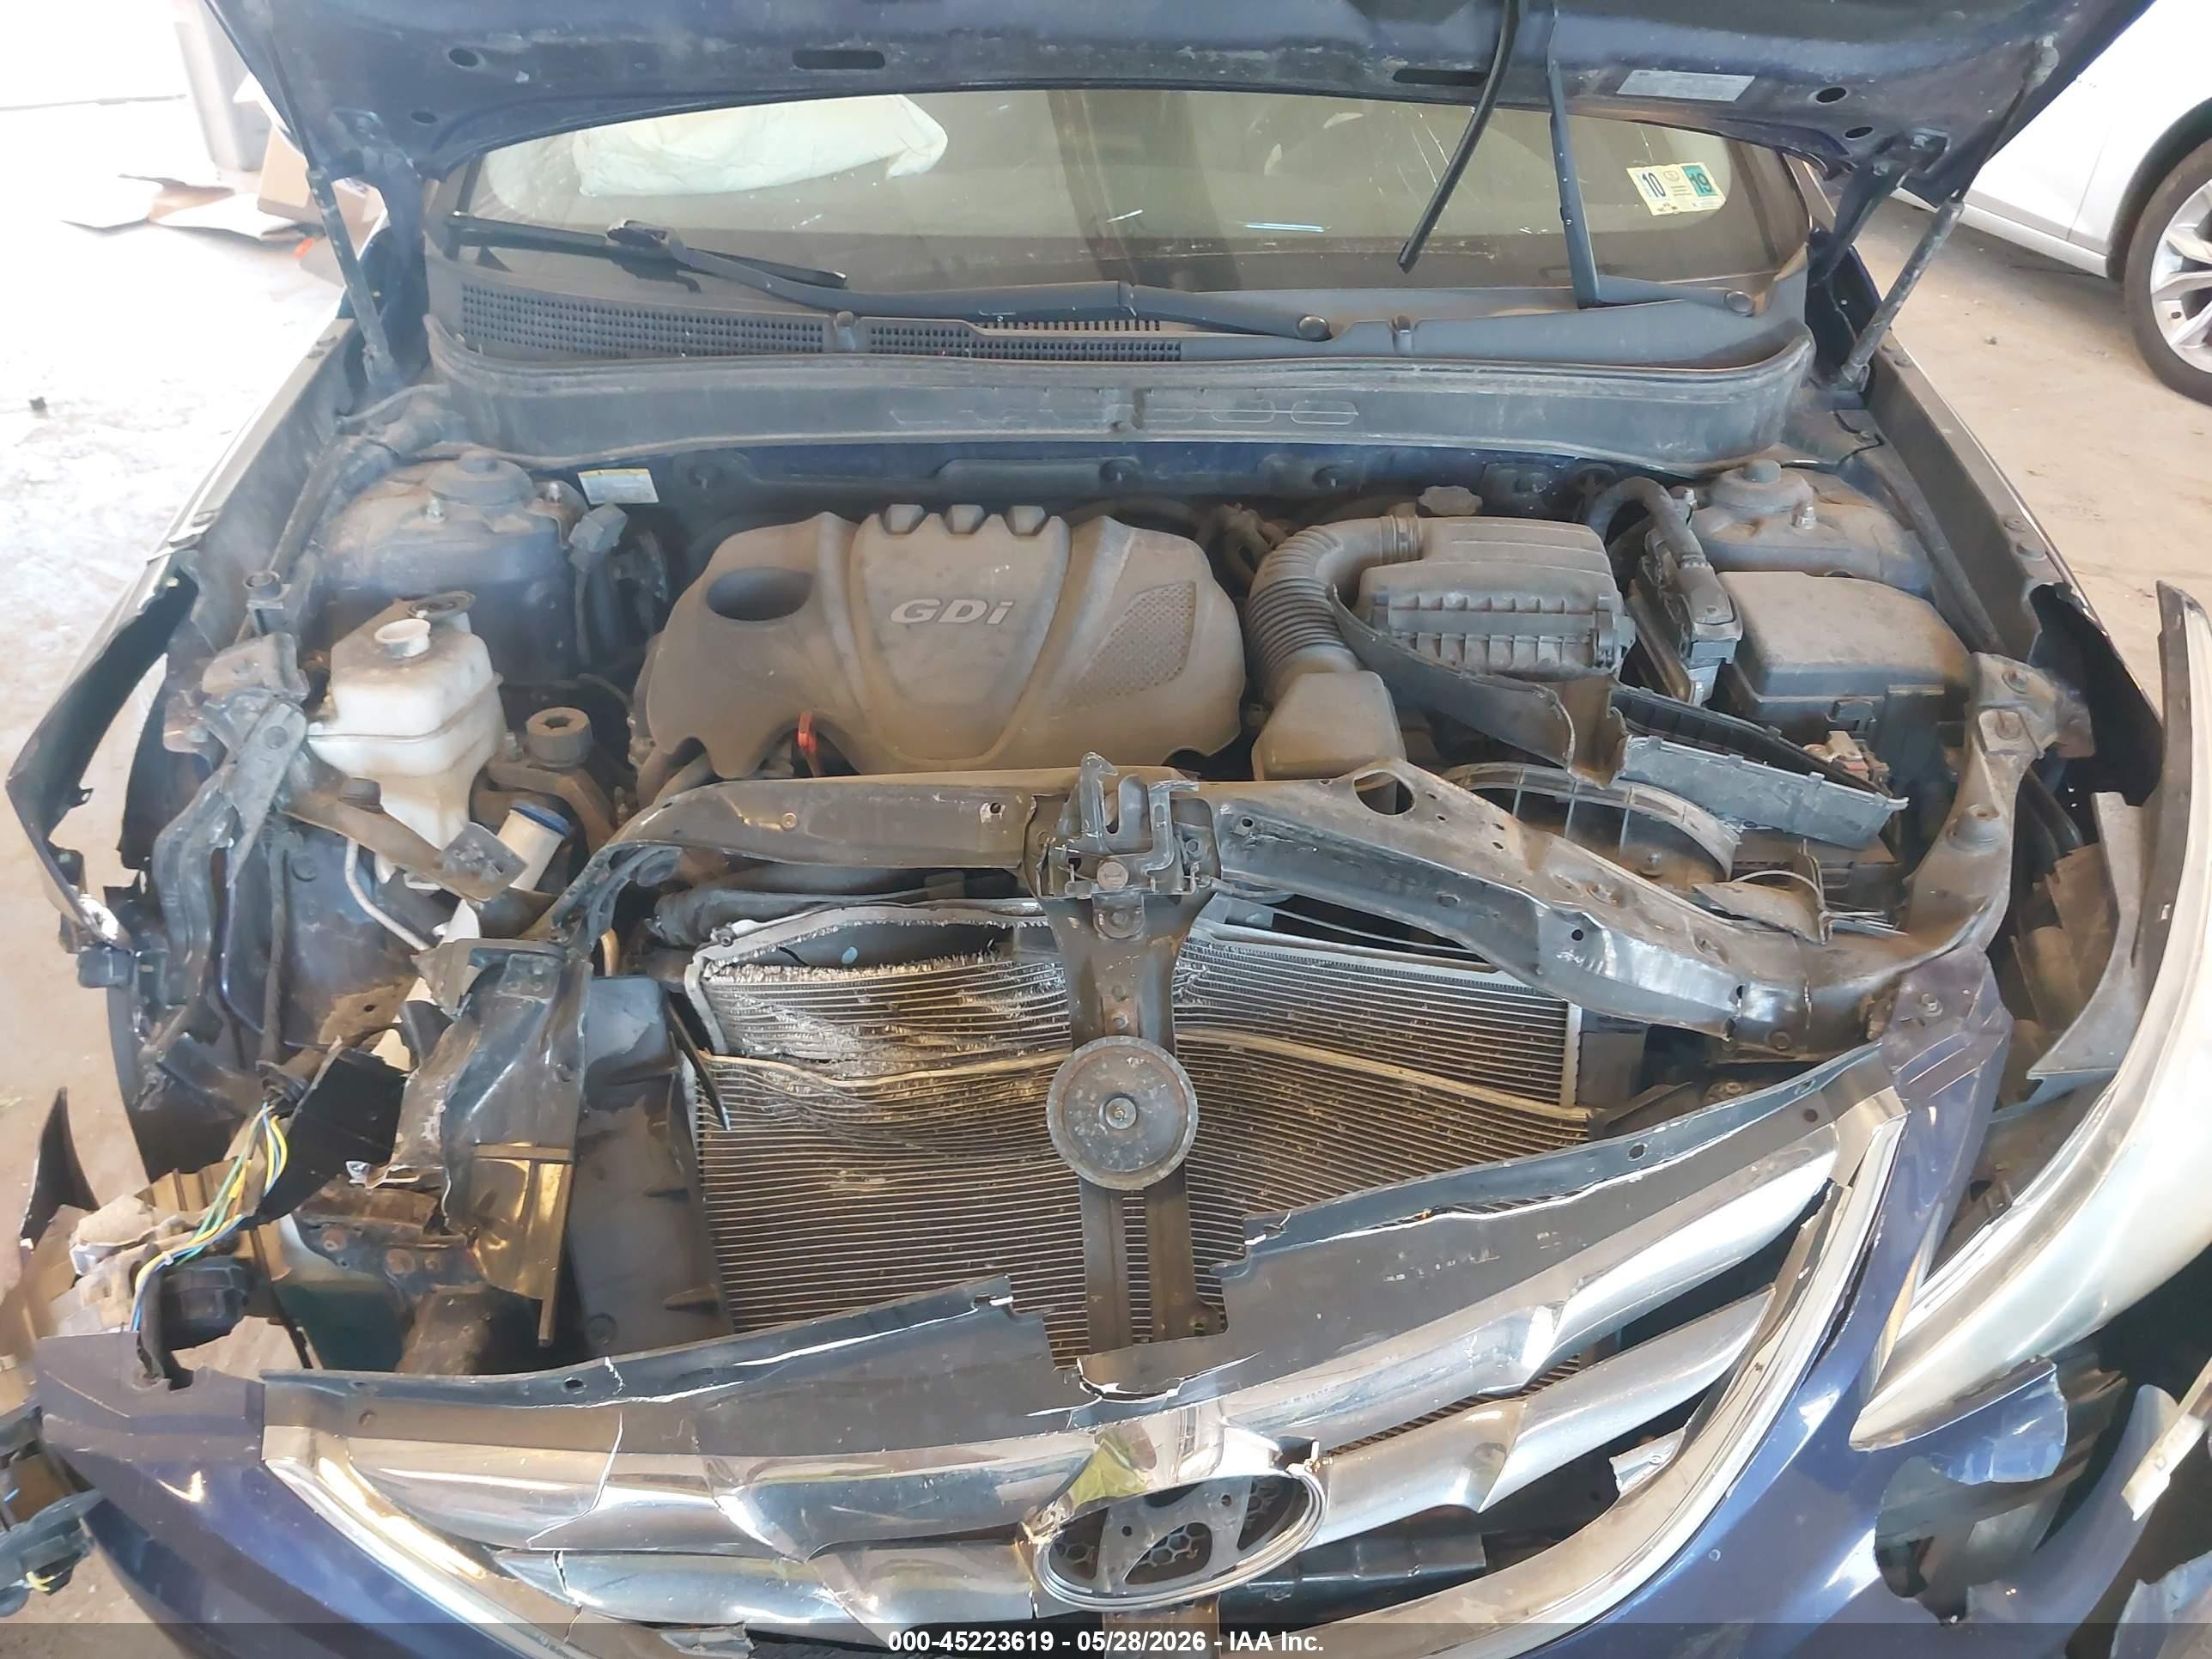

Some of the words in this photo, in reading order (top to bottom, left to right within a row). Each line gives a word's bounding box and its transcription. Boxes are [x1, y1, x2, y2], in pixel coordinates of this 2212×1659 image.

[1641, 173, 1667, 198] 10
[1689, 173, 1713, 194] 19
[890, 599, 1015, 625] GDi
